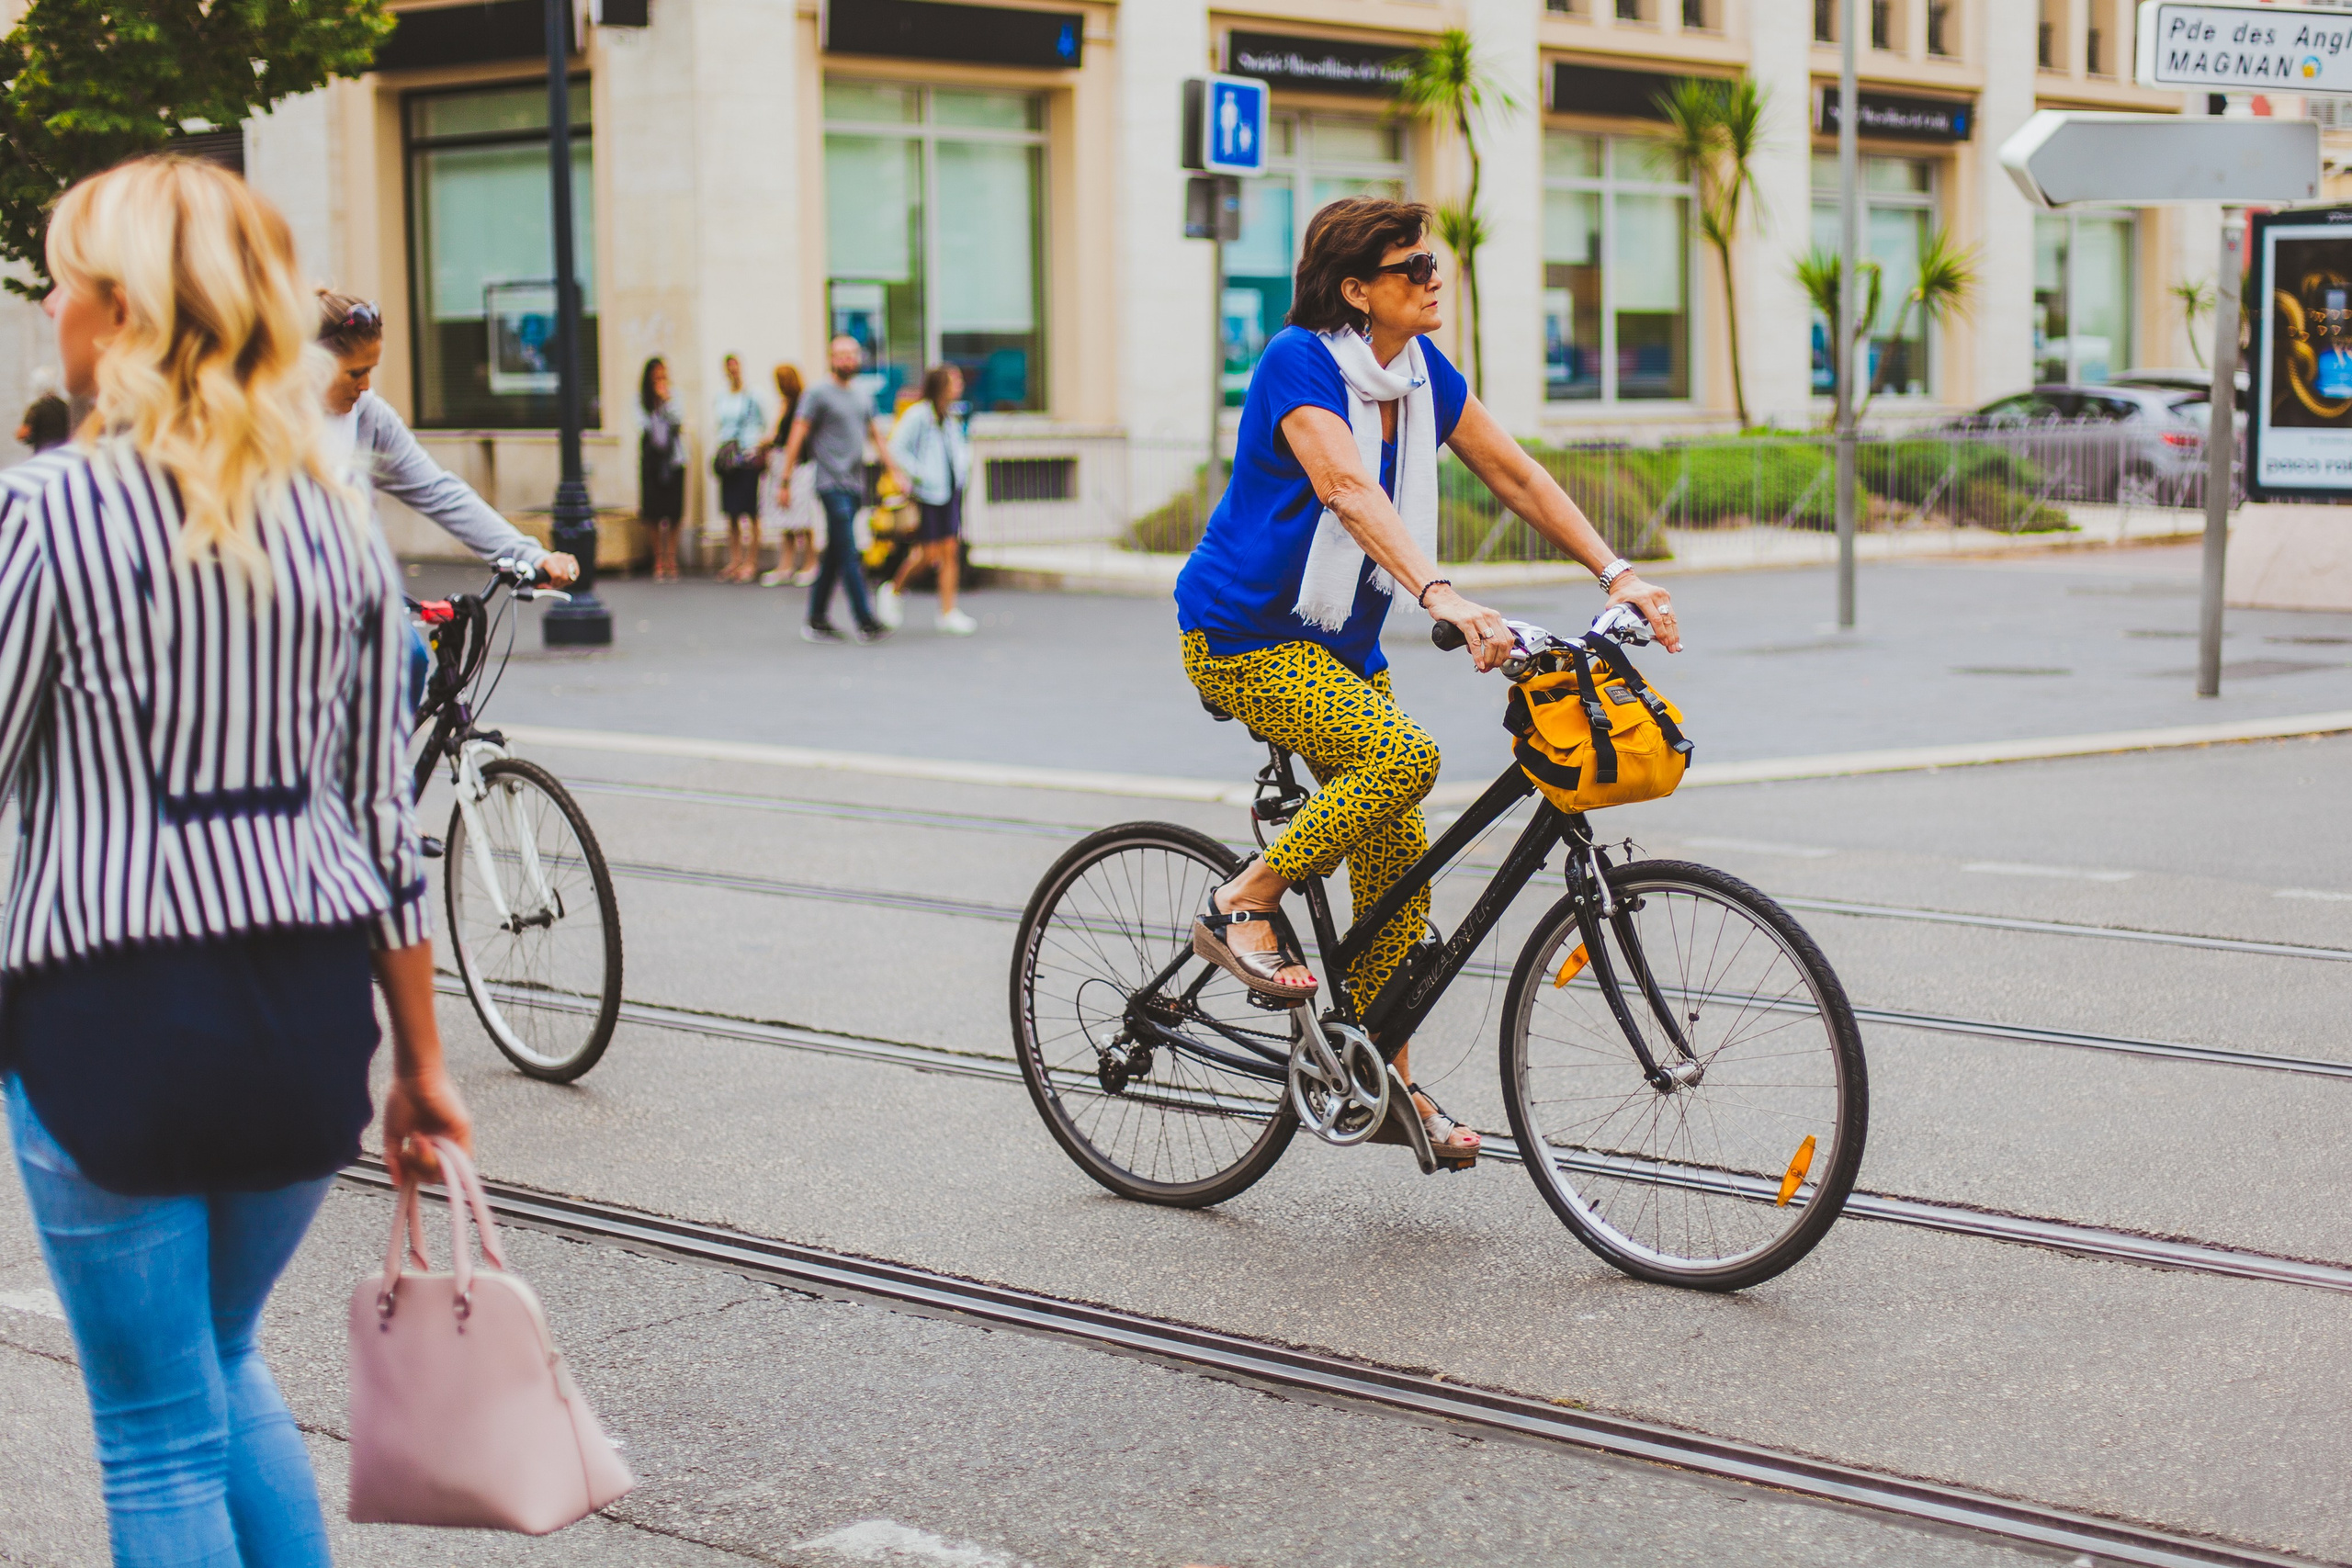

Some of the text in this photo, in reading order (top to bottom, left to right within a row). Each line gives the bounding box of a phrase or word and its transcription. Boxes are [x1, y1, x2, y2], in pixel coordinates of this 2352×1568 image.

[2169, 17, 2215, 41] Pde
[2233, 20, 2276, 46] des
[2167, 50, 2295, 79] MAGNAN
[1407, 890, 1488, 1010] GIANT
